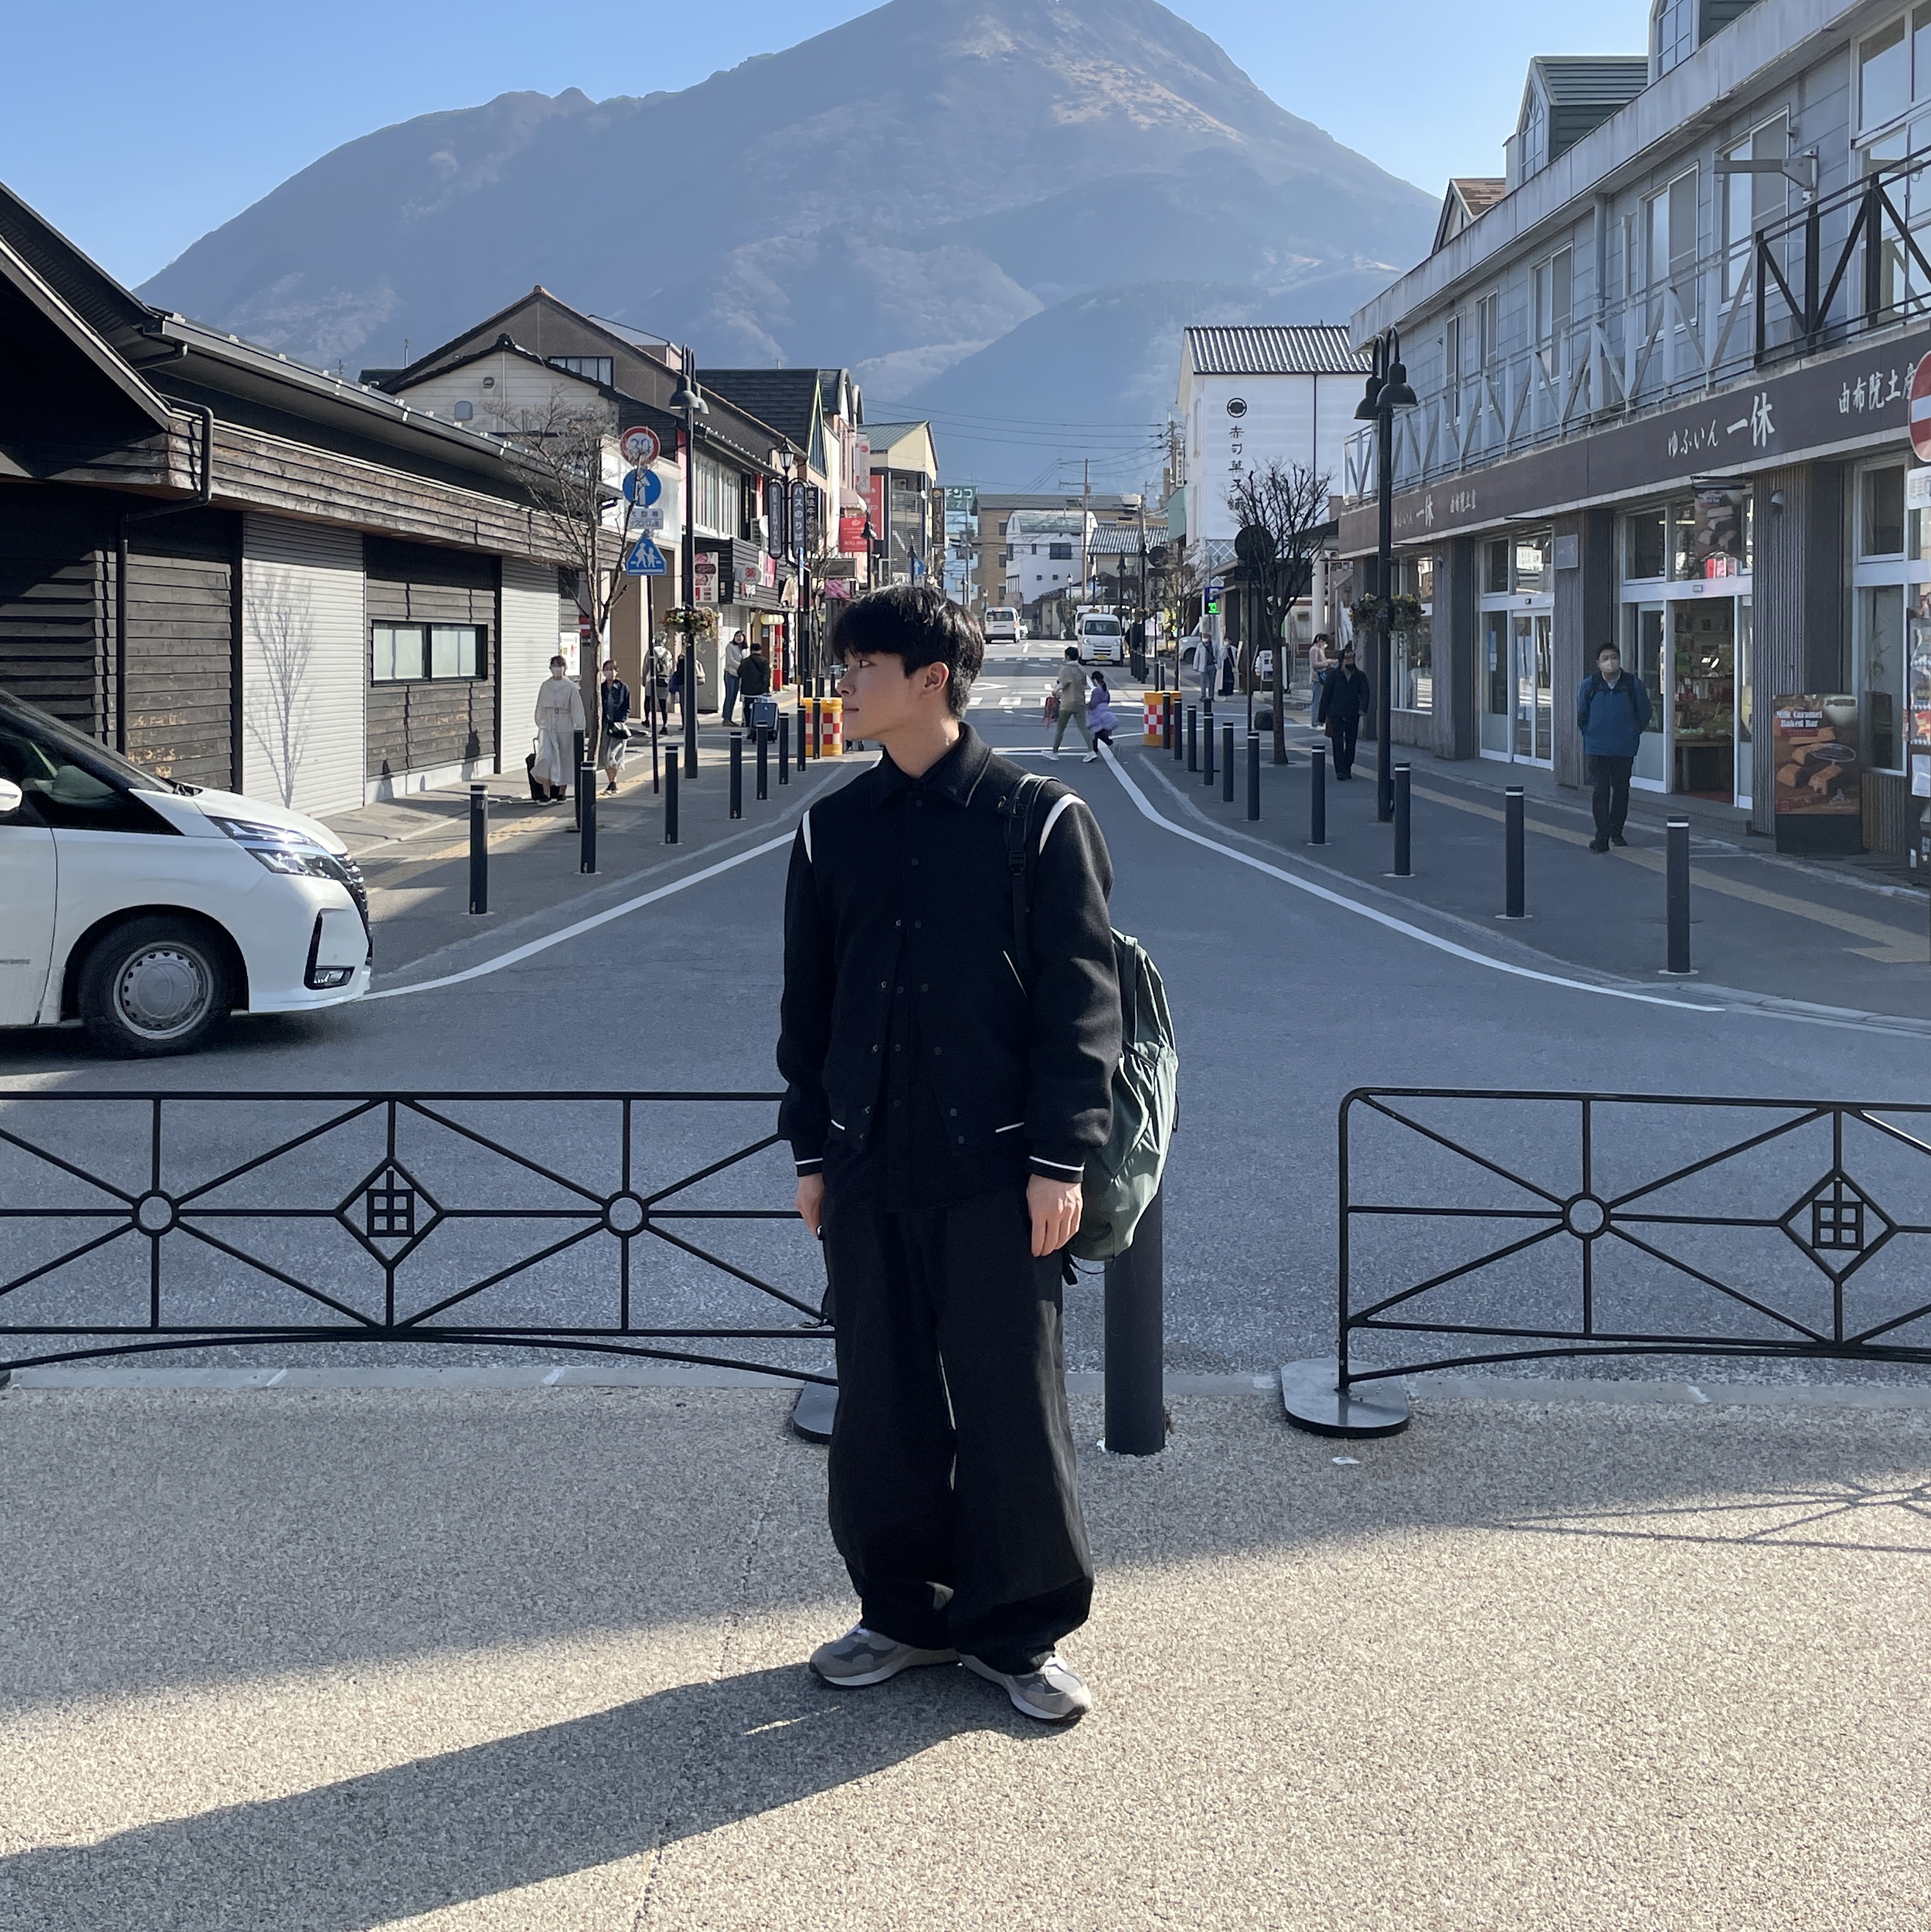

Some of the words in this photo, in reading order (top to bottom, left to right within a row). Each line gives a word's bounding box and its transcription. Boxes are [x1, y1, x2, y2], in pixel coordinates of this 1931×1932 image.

[1668, 419, 1719, 459] ゆふいん
[1726, 392, 1776, 447] 一休
[794, 487, 804, 542] バスのりば
[1416, 494, 1434, 527] 一休
